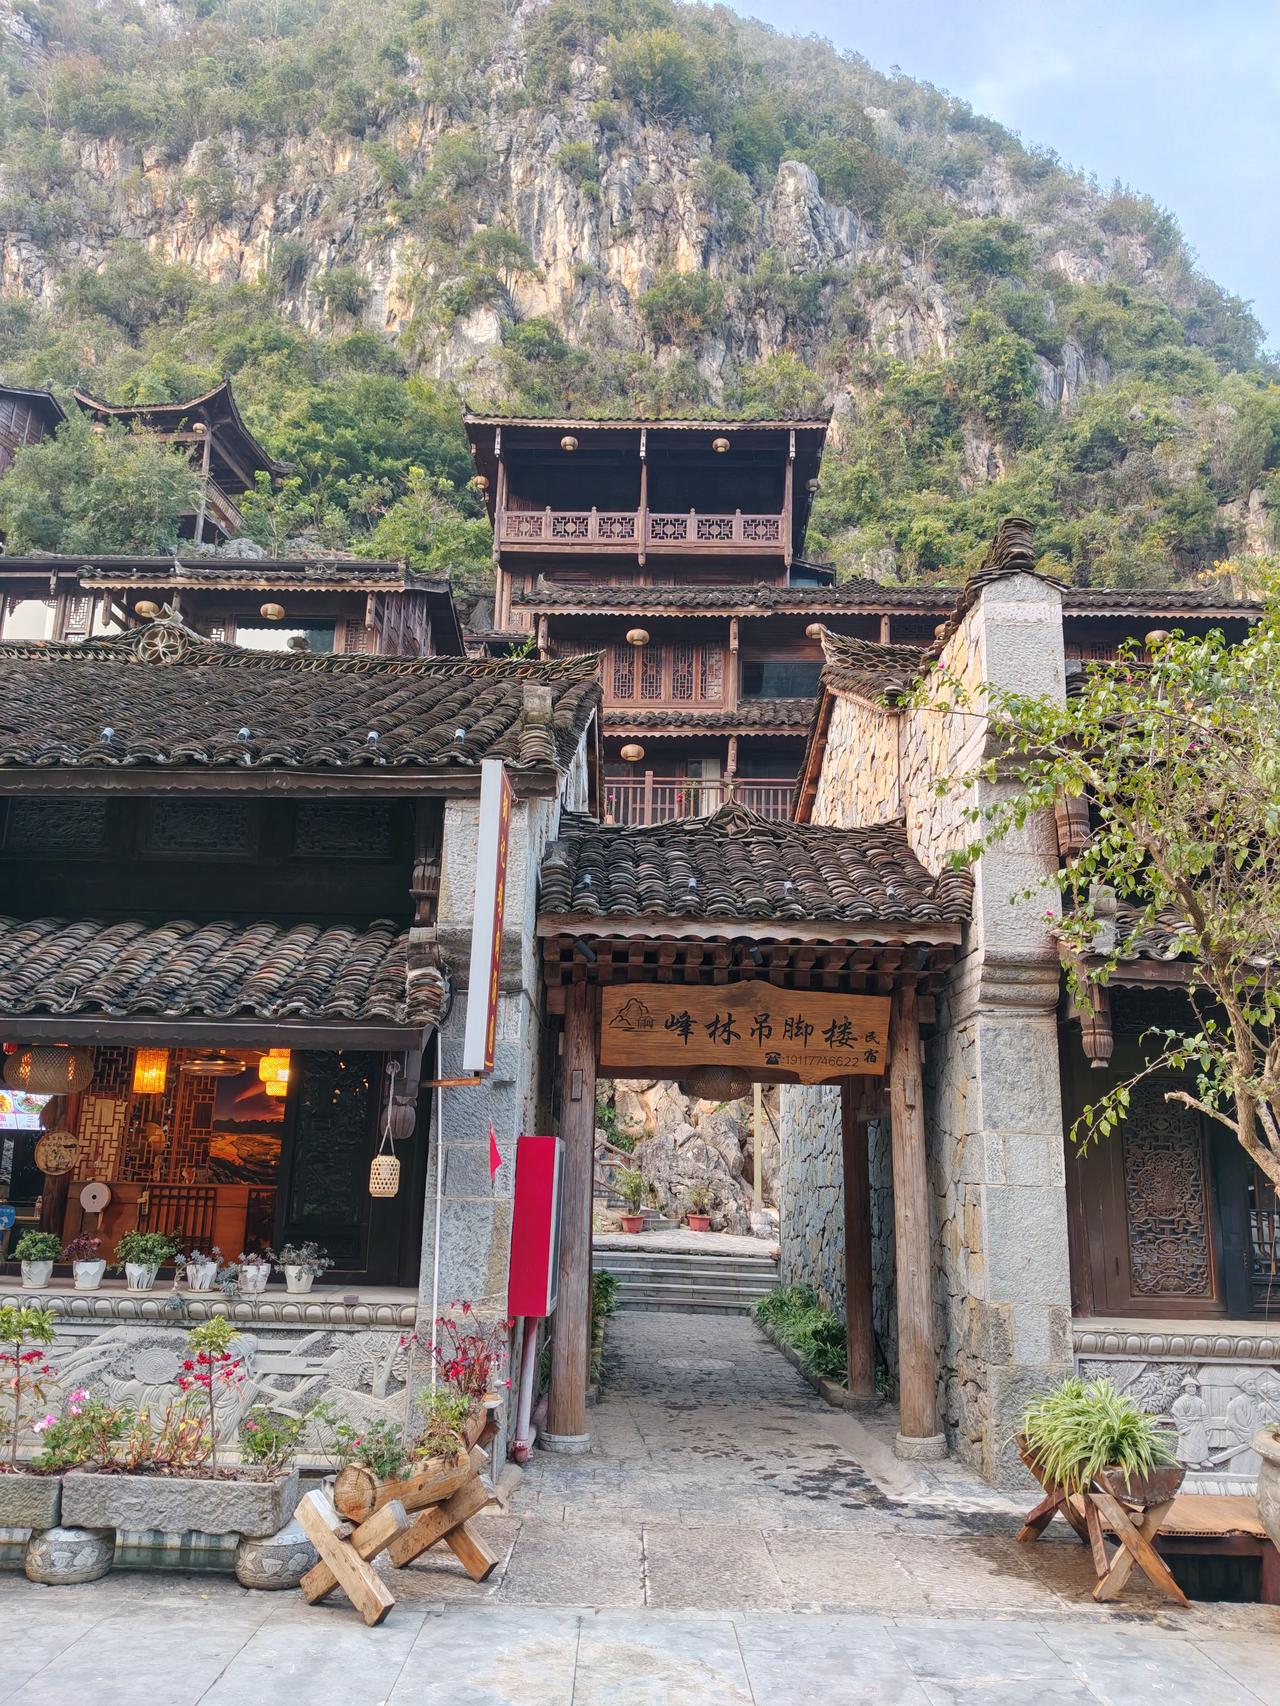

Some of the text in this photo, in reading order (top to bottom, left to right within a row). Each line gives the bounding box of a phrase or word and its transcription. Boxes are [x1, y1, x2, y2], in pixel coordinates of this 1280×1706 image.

[664, 1010, 858, 1049] 峰林吊脚楼
[864, 1031, 880, 1064] 民宿
